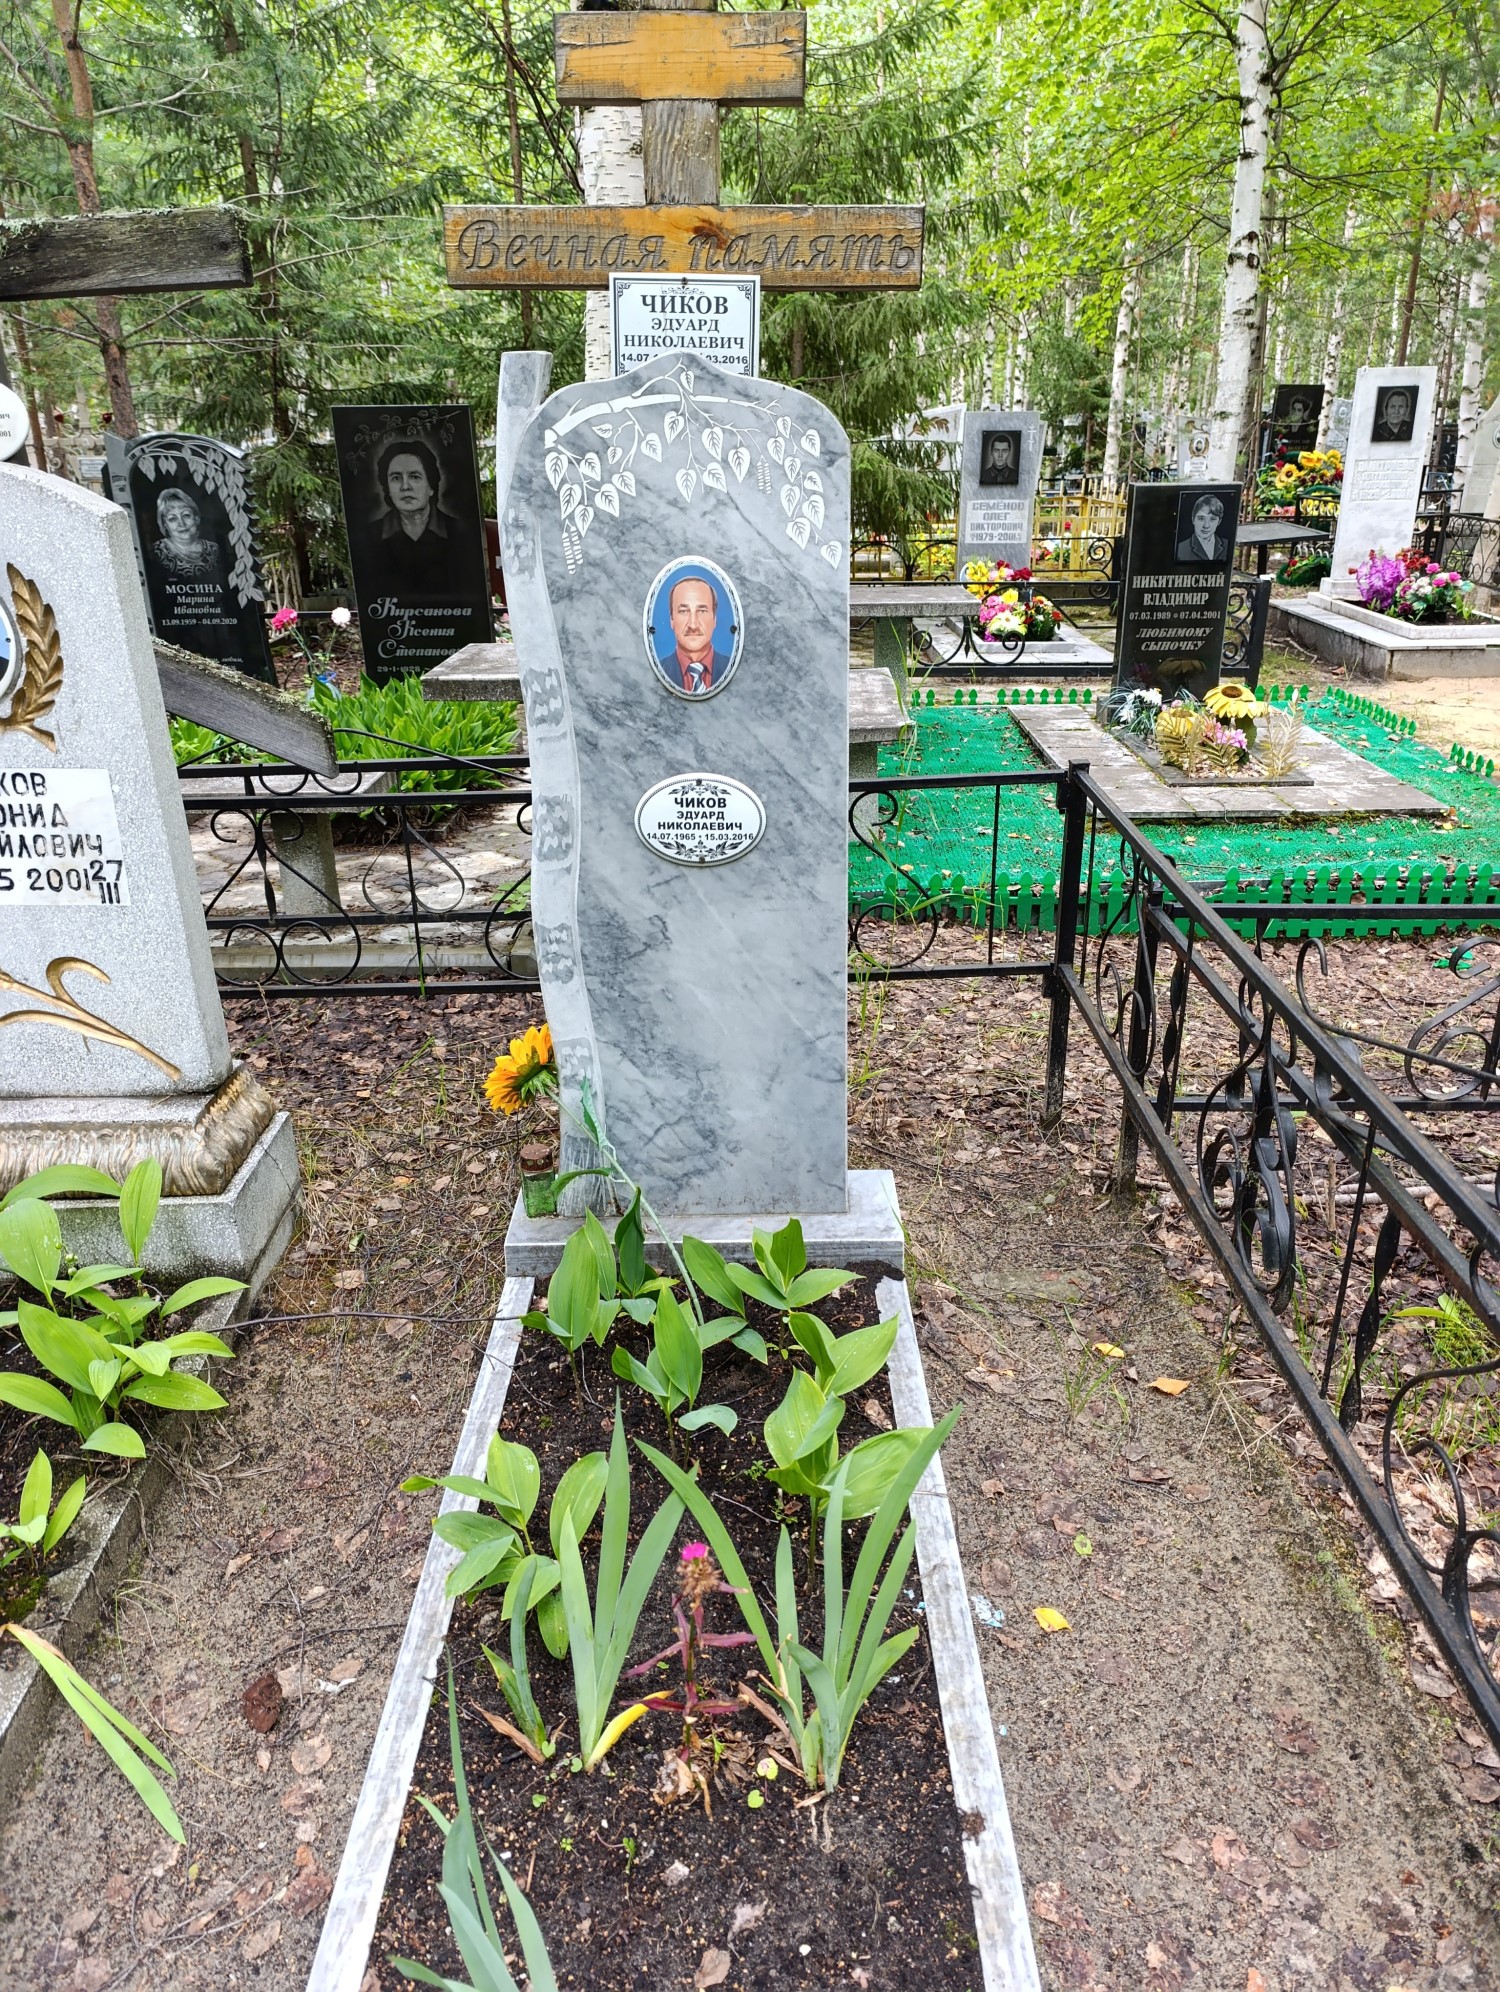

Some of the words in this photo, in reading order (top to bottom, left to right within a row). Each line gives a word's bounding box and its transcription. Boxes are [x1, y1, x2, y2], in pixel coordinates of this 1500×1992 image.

[458, 219, 667, 272] Вечная
[687, 231, 917, 274] память
[640, 294, 729, 315] ЧИКОВ
[651, 317, 720, 334] ЭДУАРД
[623, 334, 745, 349] НИКОЛАЕВИЧ
[1132, 571, 1226, 589] НИКИТИНСКИЙ
[165, 584, 223, 594] МОСИНА
[176, 595, 215, 605] Марина
[1143, 593, 1210, 607] ВЛАДИМИР
[174, 605, 222, 615] Ивановна
[368, 597, 472, 620] Кирсанова
[387, 620, 455, 640] Ксения
[1136, 627, 1214, 638] ЛЮБИМОМУ
[377, 639, 460, 659] Степанов
[1141, 641, 1206, 652] СЫНОЧКУ
[674, 797, 727, 809] ЧИКОВ
[676, 811, 725, 821] ЭДУАРД
[658, 821, 743, 831] НИКОЛАЕВИЧ
[647, 832, 696, 841] 14.07.1965
[704, 832, 754, 841] 15.03.2016
